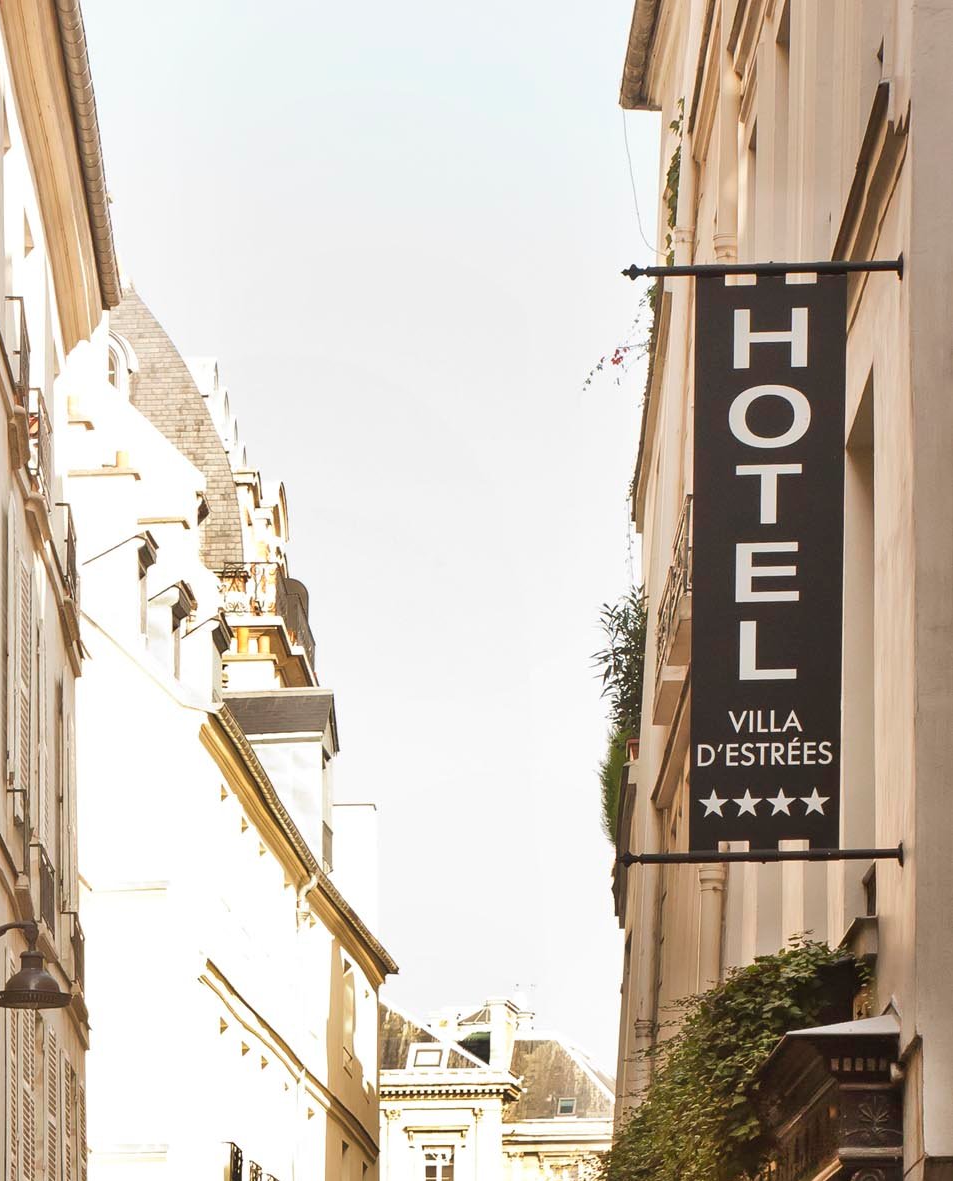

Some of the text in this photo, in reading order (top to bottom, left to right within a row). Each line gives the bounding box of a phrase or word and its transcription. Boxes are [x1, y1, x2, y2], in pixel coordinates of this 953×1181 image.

[728, 307, 812, 682] HOTEL
[728, 709, 803, 734] VILLA
[697, 737, 833, 767] D'ESTRÉES
